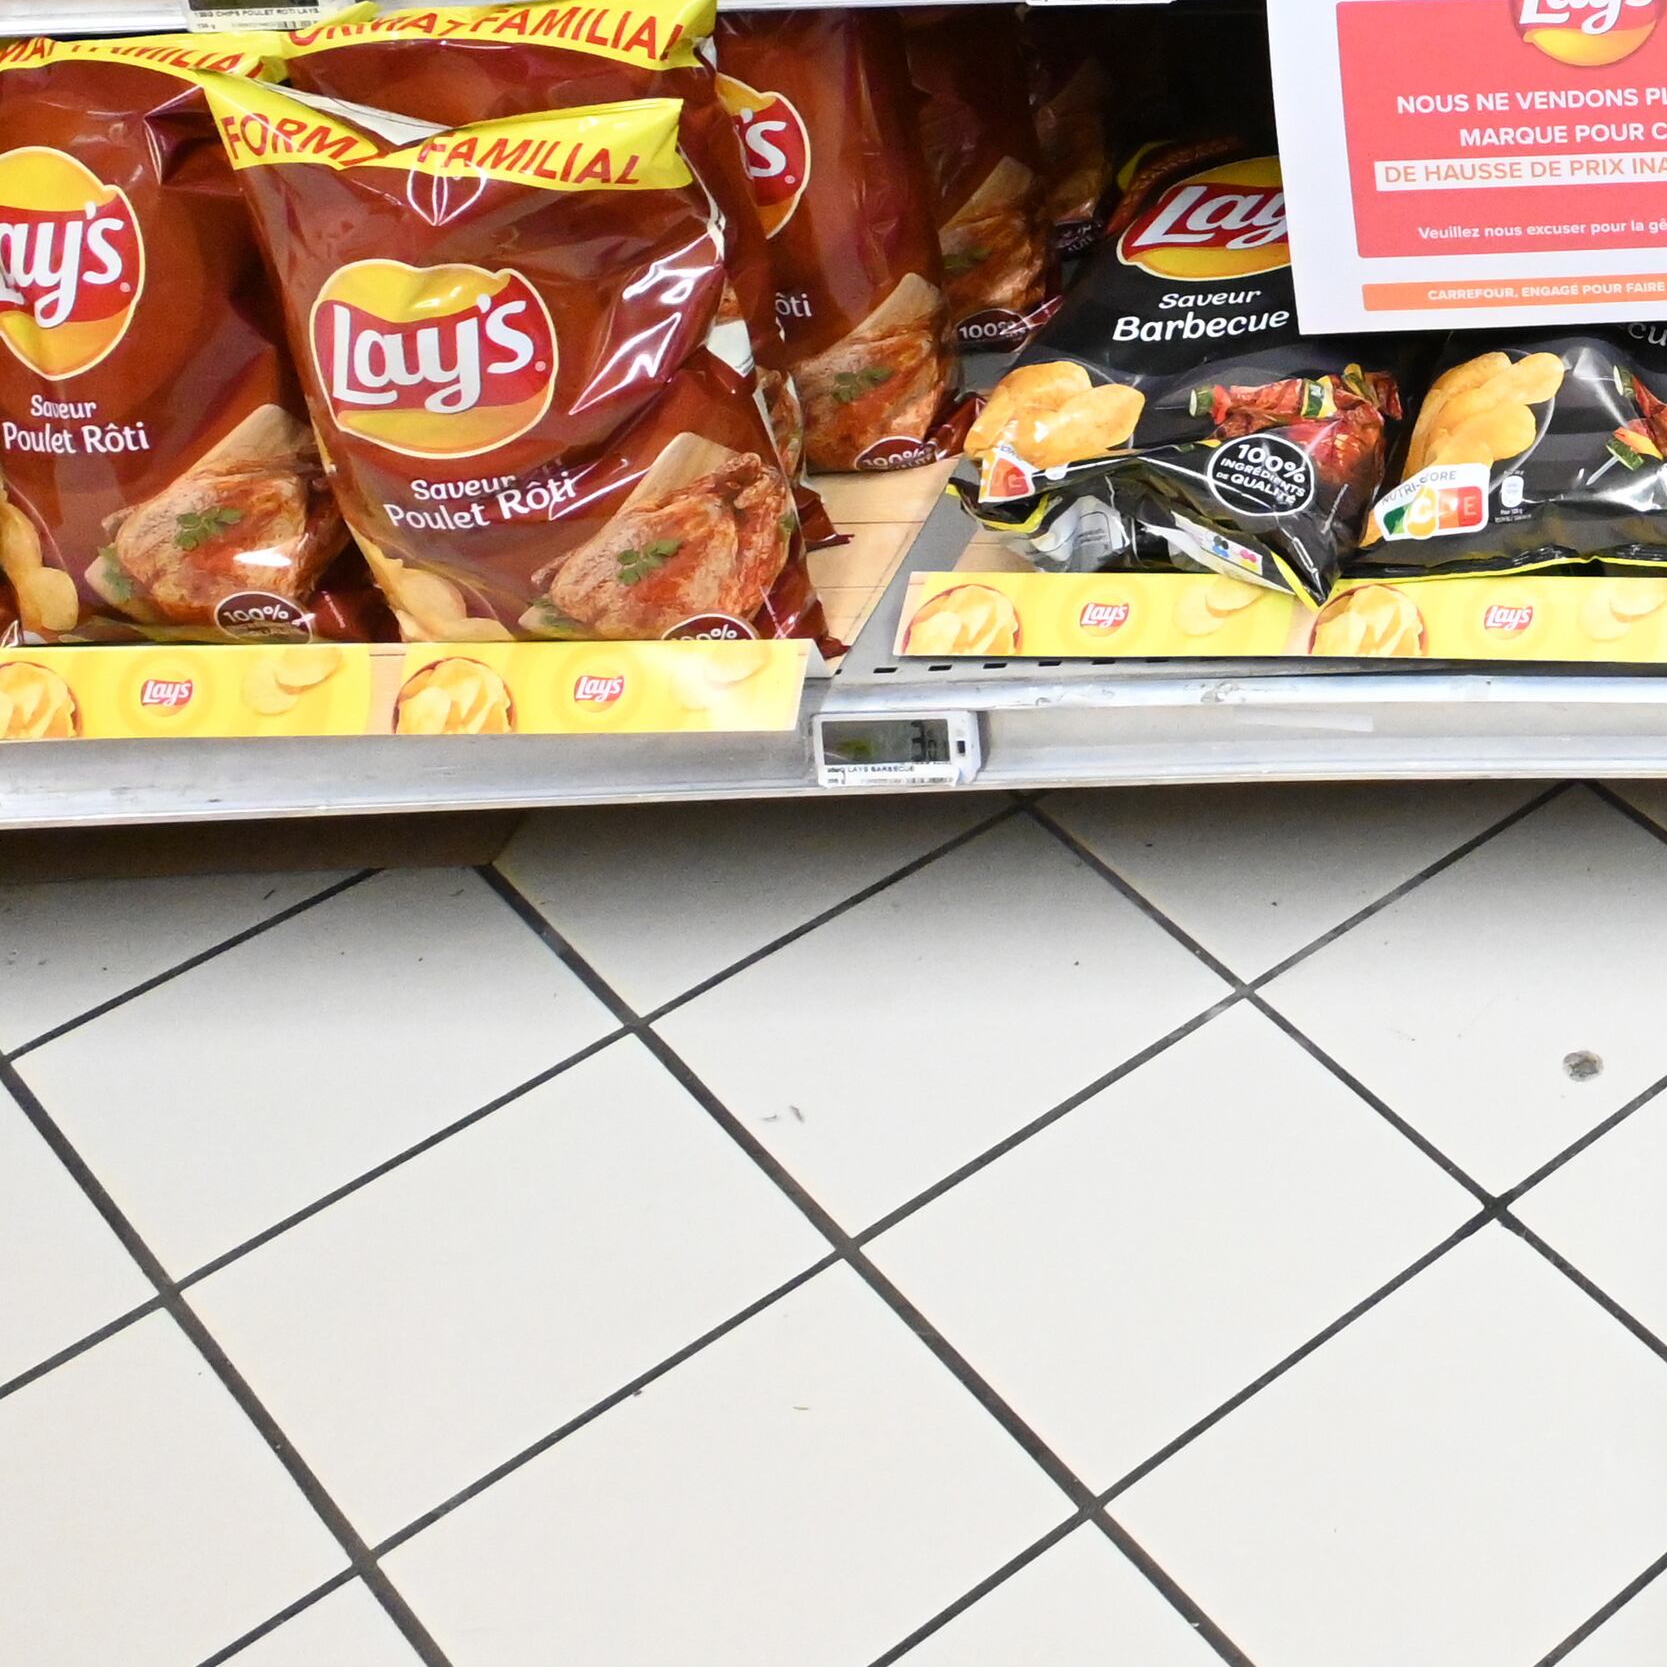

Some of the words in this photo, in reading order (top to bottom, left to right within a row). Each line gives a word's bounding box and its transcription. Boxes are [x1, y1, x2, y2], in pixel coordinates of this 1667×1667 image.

[1397, 94, 1469, 115] NOUS
[1477, 92, 1508, 112] NE
[1516, 88, 1638, 110] VENDONS
[1460, 125, 1568, 147] MARQUE
[1576, 123, 1644, 143] POUR
[417, 136, 640, 184] FAMILIAL
[1385, 166, 1416, 183] DE
[1425, 162, 1523, 182] HAUSSE
[1531, 160, 1562, 178] DE
[1570, 157, 1625, 177] PRIX
[1418, 225, 1480, 240] Veuillez
[1485, 225, 1522, 237] nous
[1527, 223, 1586, 235] excuser
[1591, 221, 1627, 238] pour
[1631, 218, 1645, 232] la
[1159, 288, 1261, 308] Saveur
[1428, 288, 1519, 301] CARREFOUR,
[1583, 283, 1622, 295] POUR
[1626, 281, 1665, 293] FAIRE
[1113, 307, 1290, 344] Barbecue
[332, 295, 532, 412] Lay's
[411, 474, 516, 500] Saveur
[386, 500, 488, 531] Poulet
[496, 472, 577, 522] Rôti
[141, 681, 192, 706] Lay's
